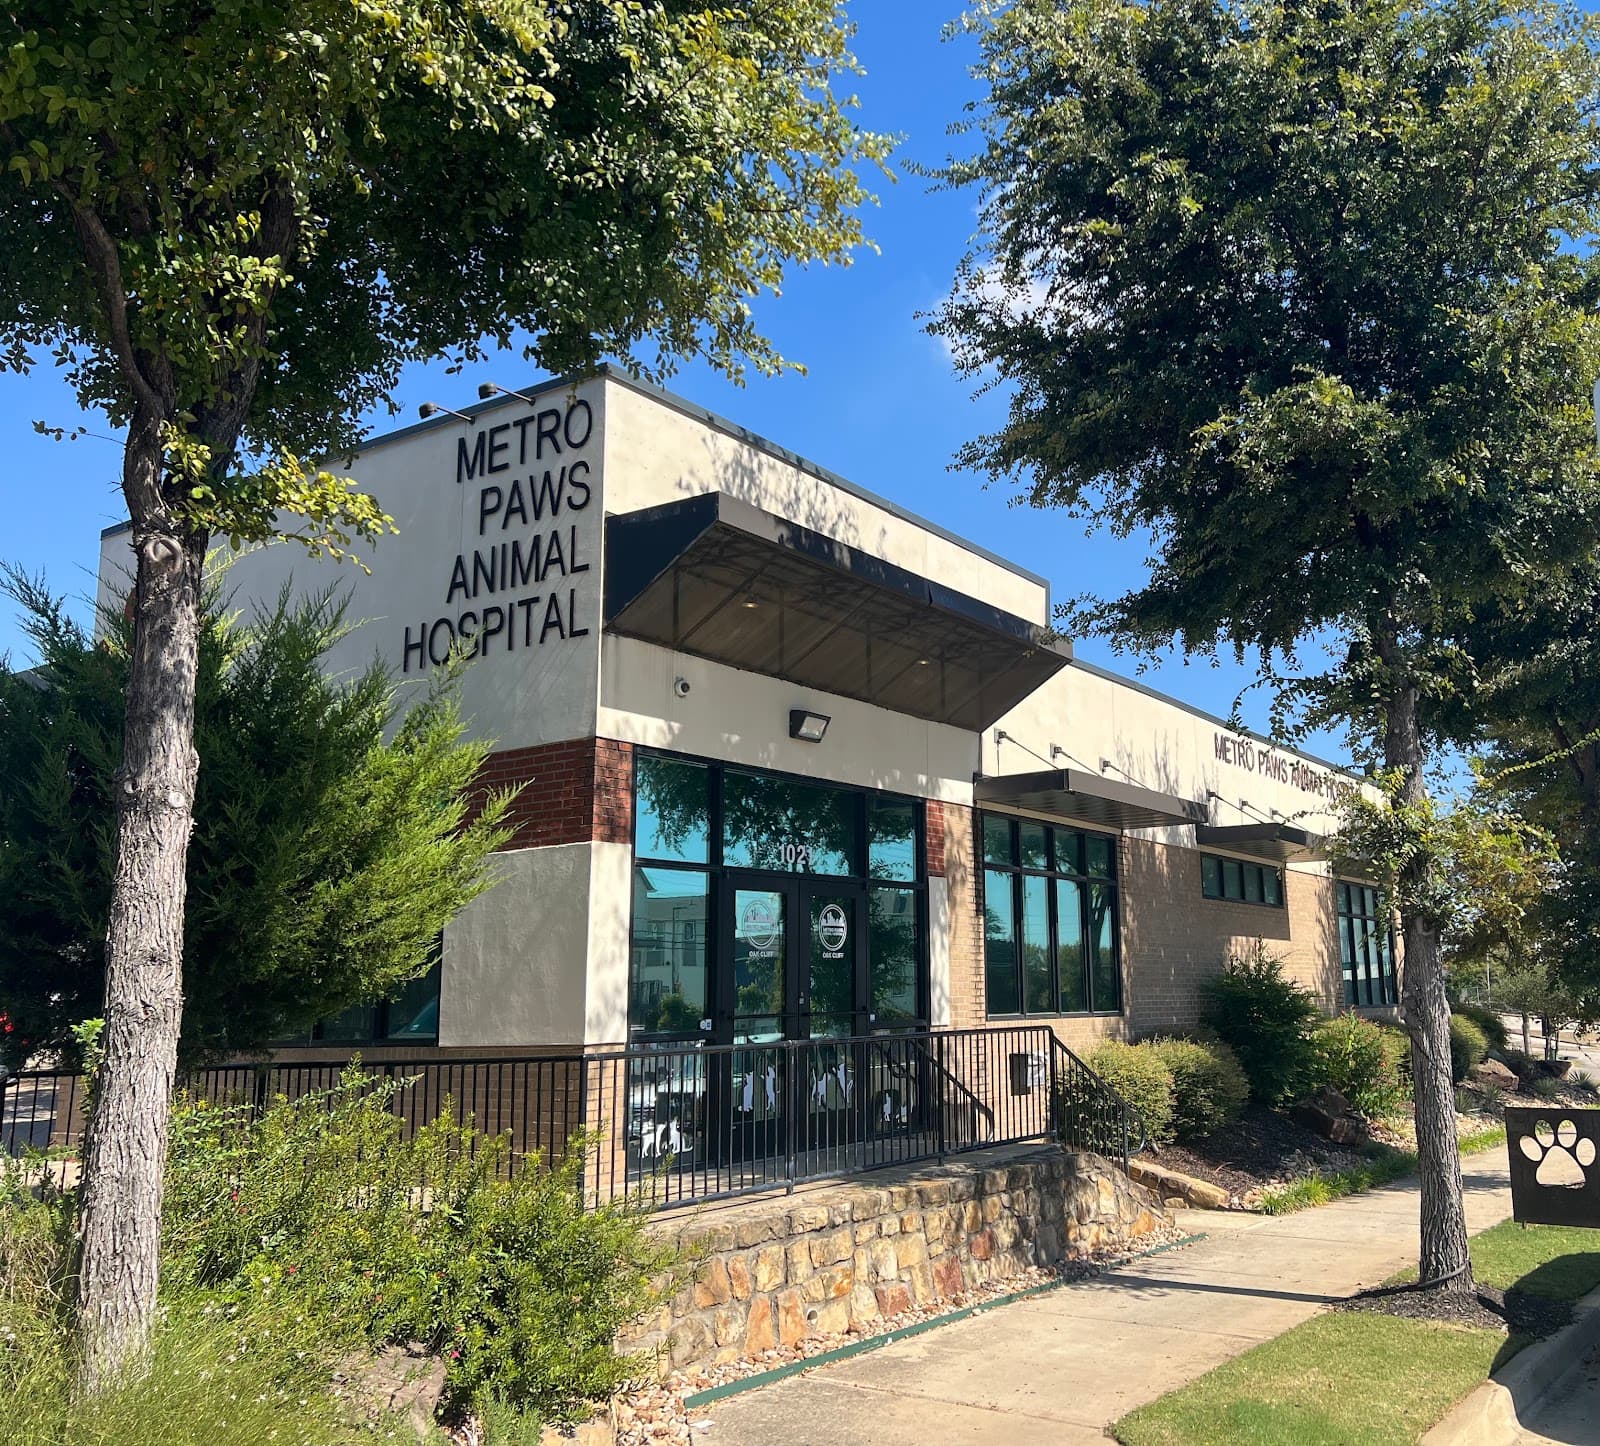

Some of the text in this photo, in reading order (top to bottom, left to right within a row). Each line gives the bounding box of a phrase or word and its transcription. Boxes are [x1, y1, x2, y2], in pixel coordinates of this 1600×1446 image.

[456, 399, 592, 484] METRO
[479, 460, 591, 536] PAWS
[446, 525, 589, 604] ANIMAL
[403, 588, 589, 673] HOSPITAL
[1214, 732, 1255, 772] METRO
[1258, 749, 1288, 784] PAWS
[778, 843, 813, 865] 1021
